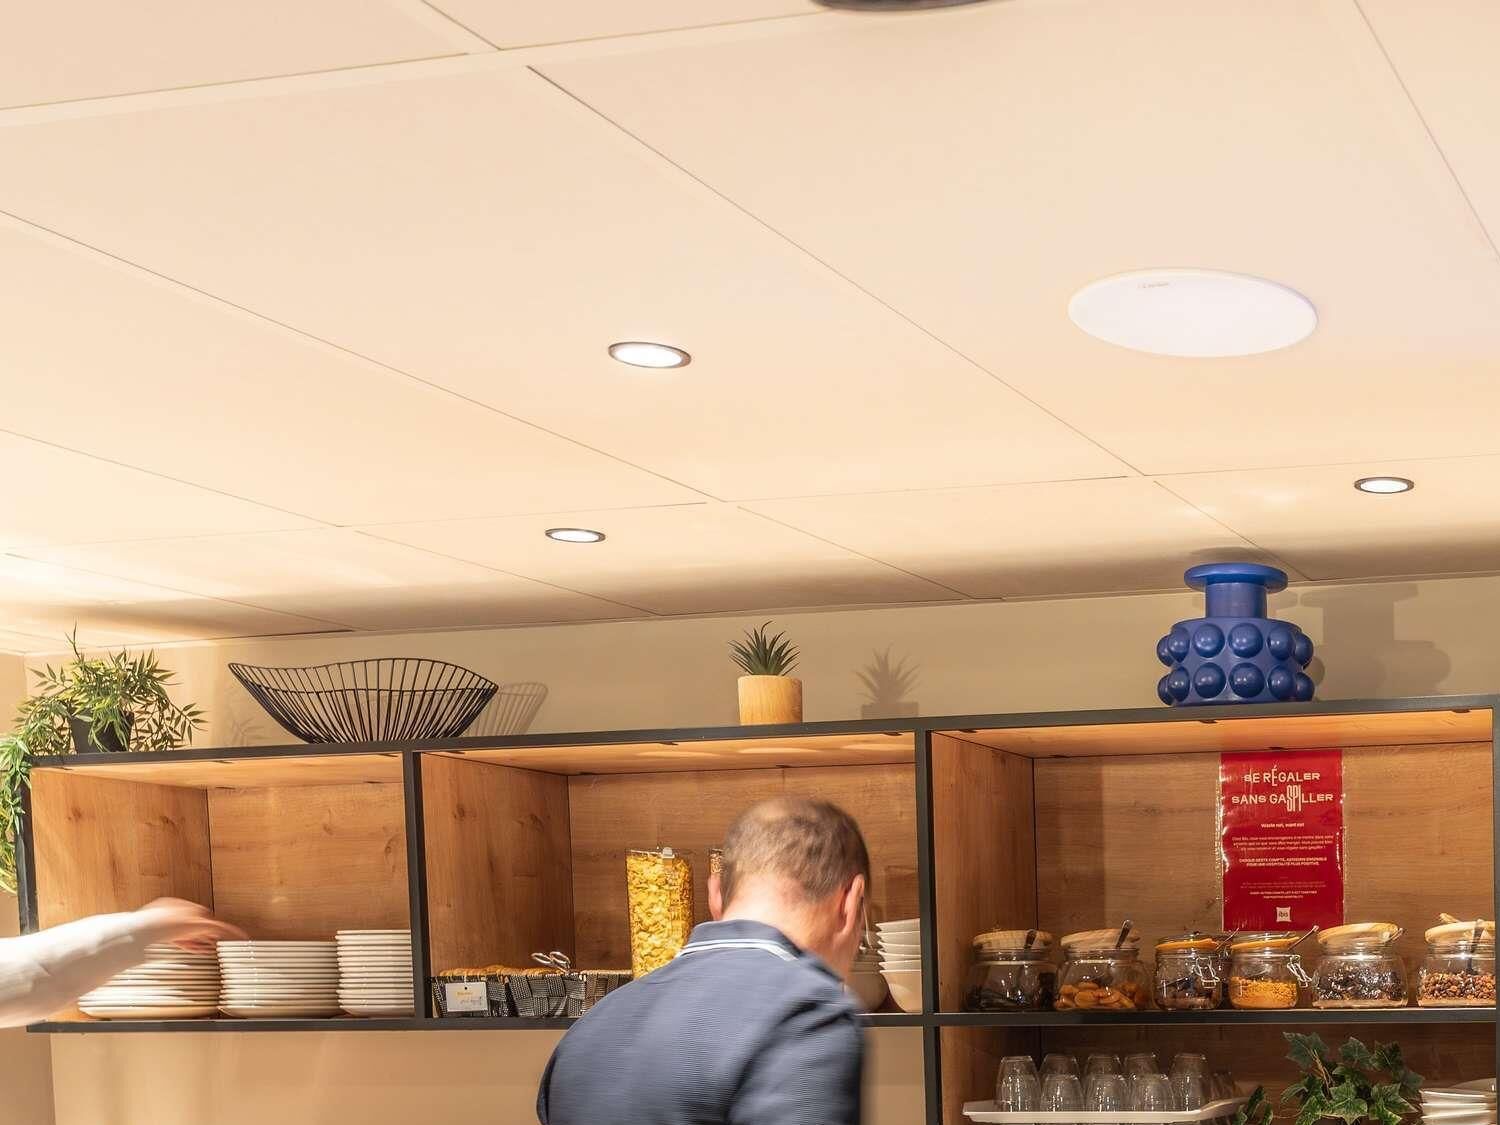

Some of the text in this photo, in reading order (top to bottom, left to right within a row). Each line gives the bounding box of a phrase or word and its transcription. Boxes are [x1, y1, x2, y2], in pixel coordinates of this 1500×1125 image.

[1244, 765, 1321, 787] SE RÉGALER
[1231, 785, 1334, 812] SANS GASPILLER
